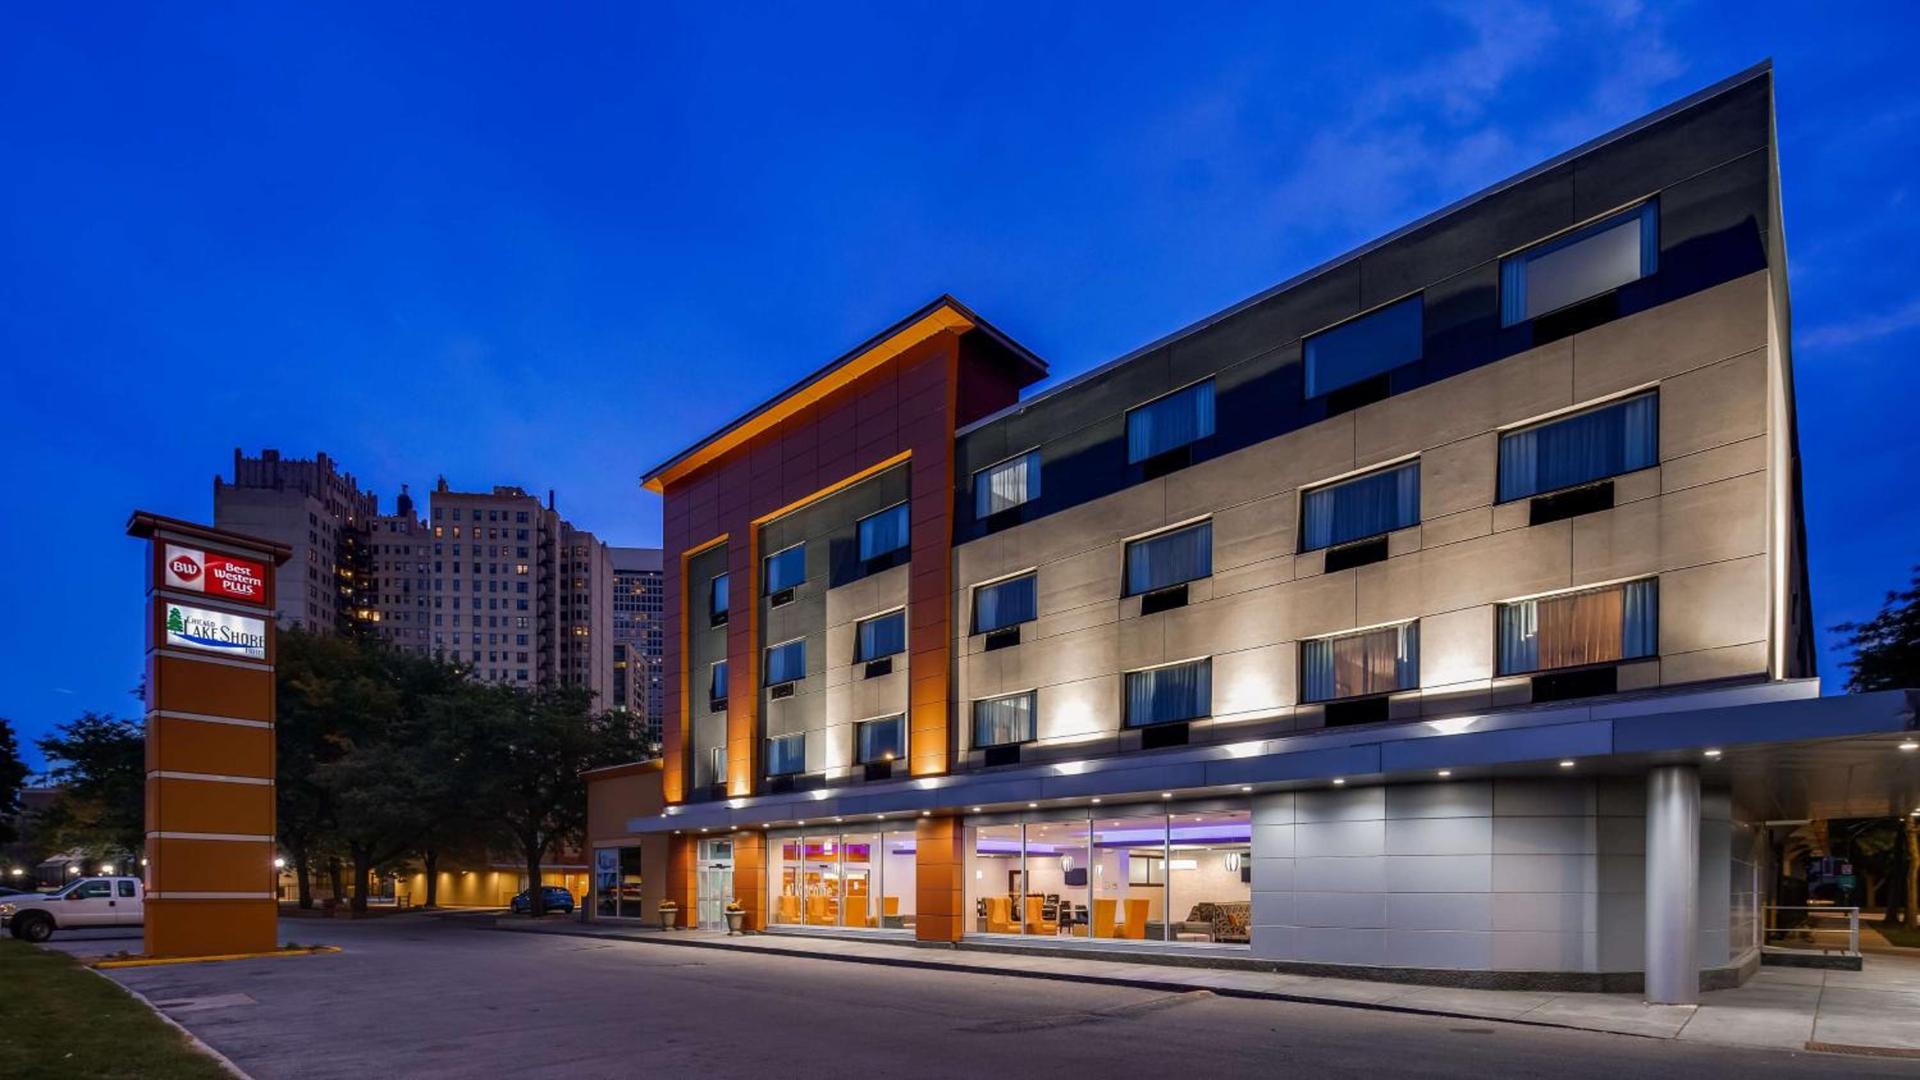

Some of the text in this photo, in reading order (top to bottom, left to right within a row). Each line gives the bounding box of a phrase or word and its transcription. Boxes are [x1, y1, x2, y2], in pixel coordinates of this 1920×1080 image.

[173, 561, 198, 575] BW
[225, 562, 251, 576] Best
[214, 568, 262, 587] Western
[222, 580, 253, 594] PLUS
